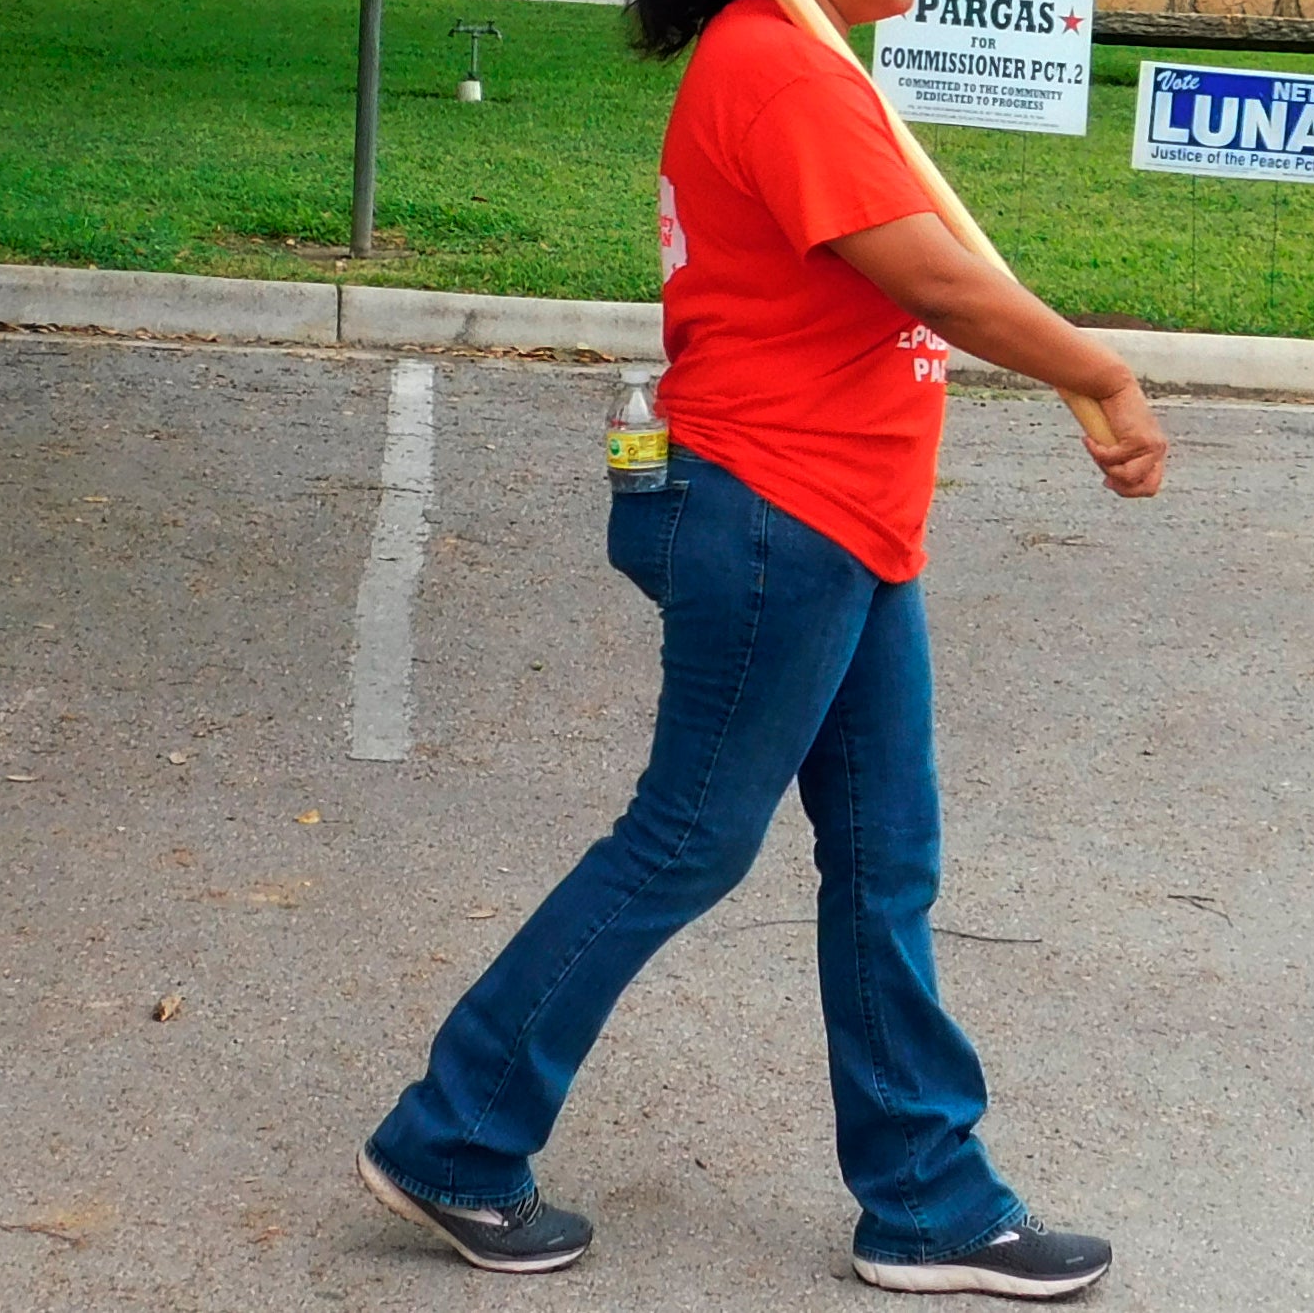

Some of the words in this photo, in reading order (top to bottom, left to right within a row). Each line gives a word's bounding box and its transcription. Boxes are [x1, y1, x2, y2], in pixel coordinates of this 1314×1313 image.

[971, 36, 996, 50] FOR
[880, 46, 1025, 81] COMMISSIONER
[898, 77, 961, 93] COMMITTED
[963, 83, 977, 94] TO
[979, 84, 999, 96] THE
[1001, 86, 1063, 101] COMMUNITY
[1156, 70, 1201, 92] Vote
[915, 90, 974, 105] DEDICATED
[976, 96, 990, 106] TO
[992, 97, 1045, 111] PROGRESS
[1151, 146, 1201, 163] Justice
[1207, 152, 1220, 164] of
[1225, 153, 1246, 166] the
[1250, 154, 1290, 170] Peace
